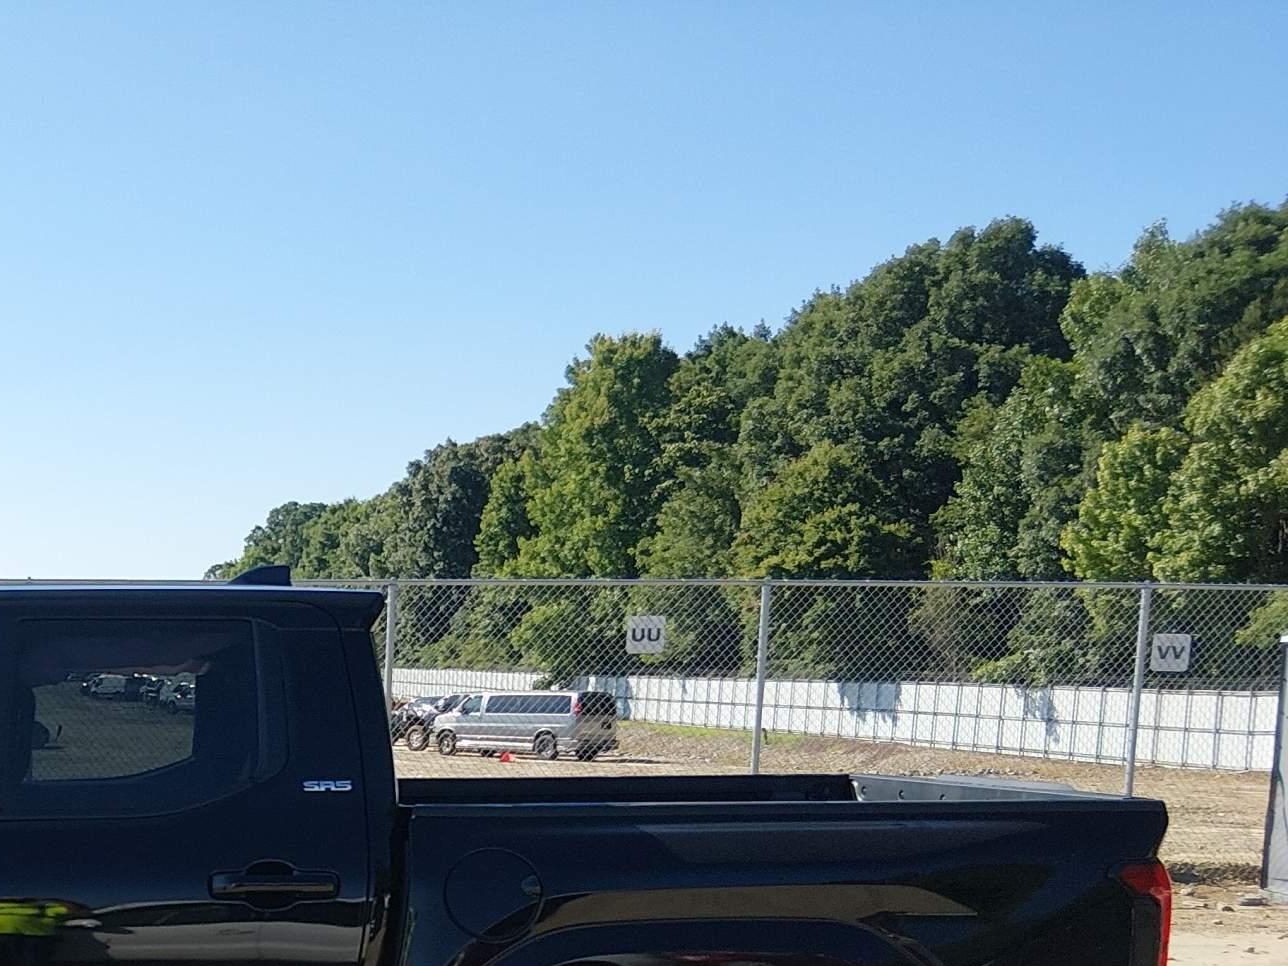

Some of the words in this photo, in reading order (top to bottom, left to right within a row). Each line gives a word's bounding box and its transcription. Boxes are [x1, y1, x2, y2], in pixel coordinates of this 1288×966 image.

[632, 628, 661, 642] UU
[1157, 645, 1185, 660] VV
[303, 780, 353, 792] SR5
